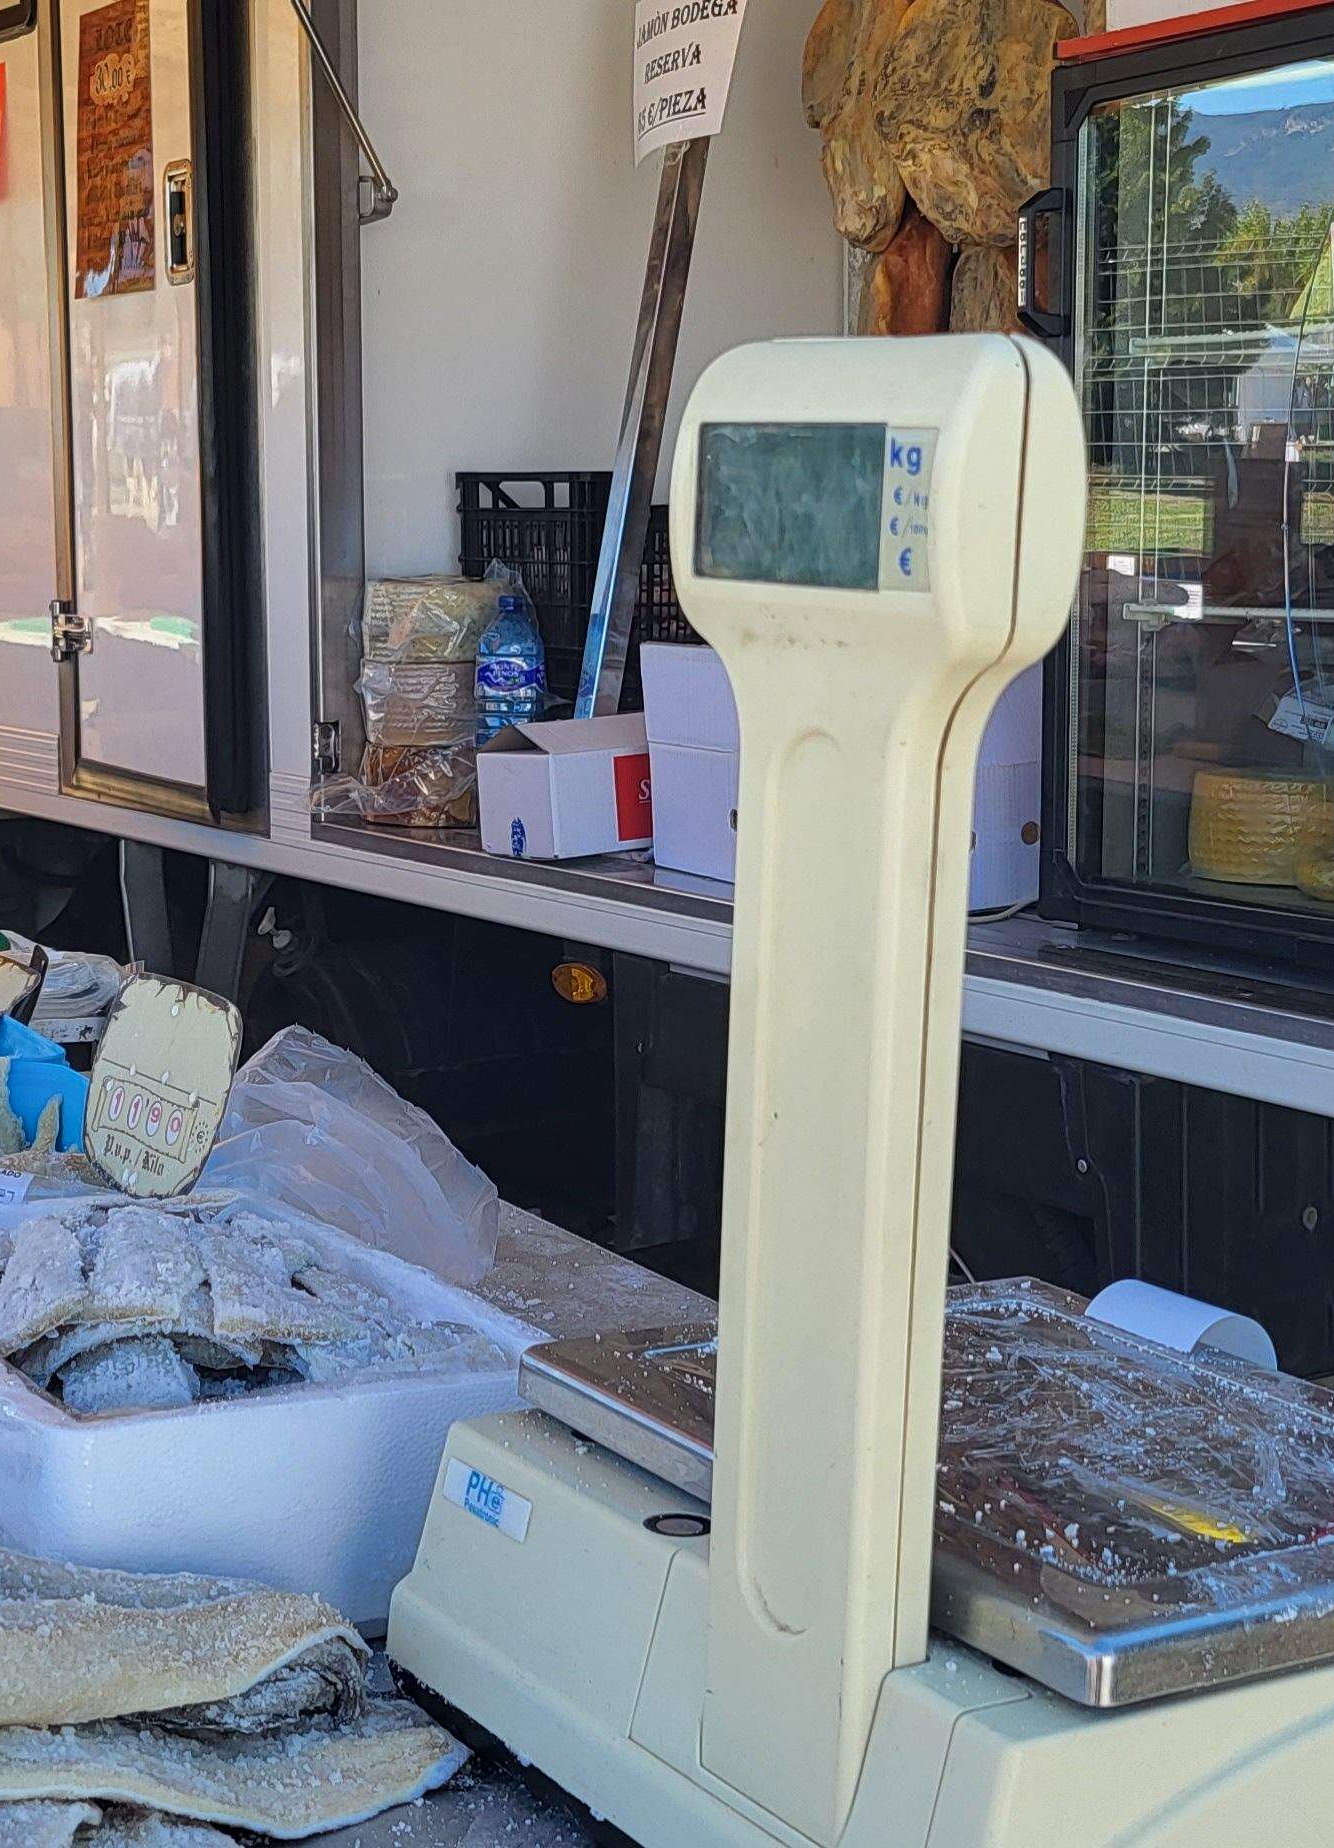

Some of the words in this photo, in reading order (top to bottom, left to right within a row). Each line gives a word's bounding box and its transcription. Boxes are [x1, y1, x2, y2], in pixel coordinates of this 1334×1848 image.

[670, 0, 738, 30] BODEGA
[644, 42, 702, 84] RESERVA
[890, 437, 922, 475] kg
[898, 547, 912, 576] €
